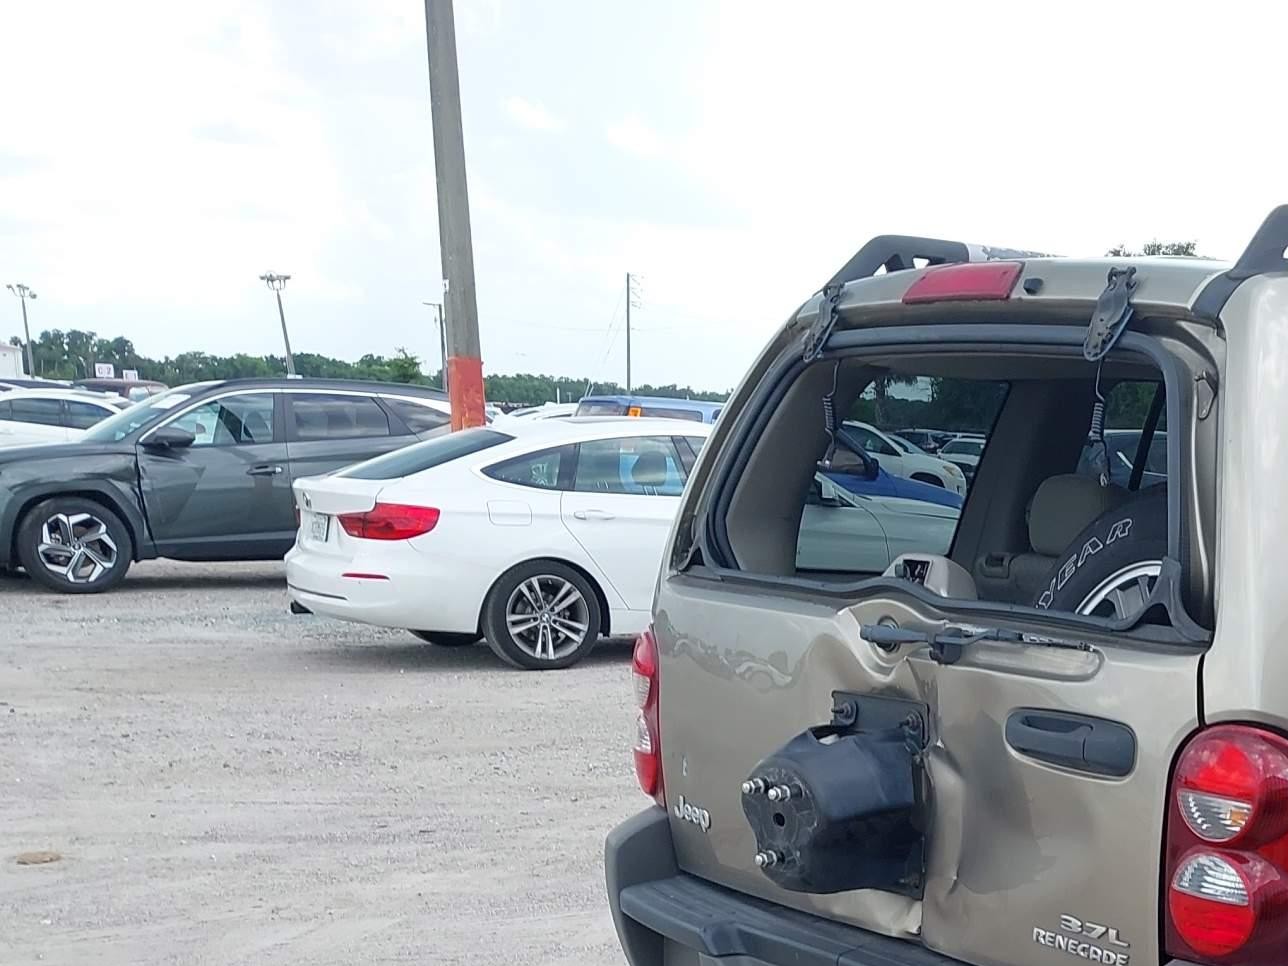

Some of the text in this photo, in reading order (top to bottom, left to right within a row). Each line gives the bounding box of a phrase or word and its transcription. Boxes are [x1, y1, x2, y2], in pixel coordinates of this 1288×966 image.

[1036, 518, 1133, 610] YEAR
[674, 795, 711, 833] Jeep
[1060, 914, 1130, 947] 3.7L
